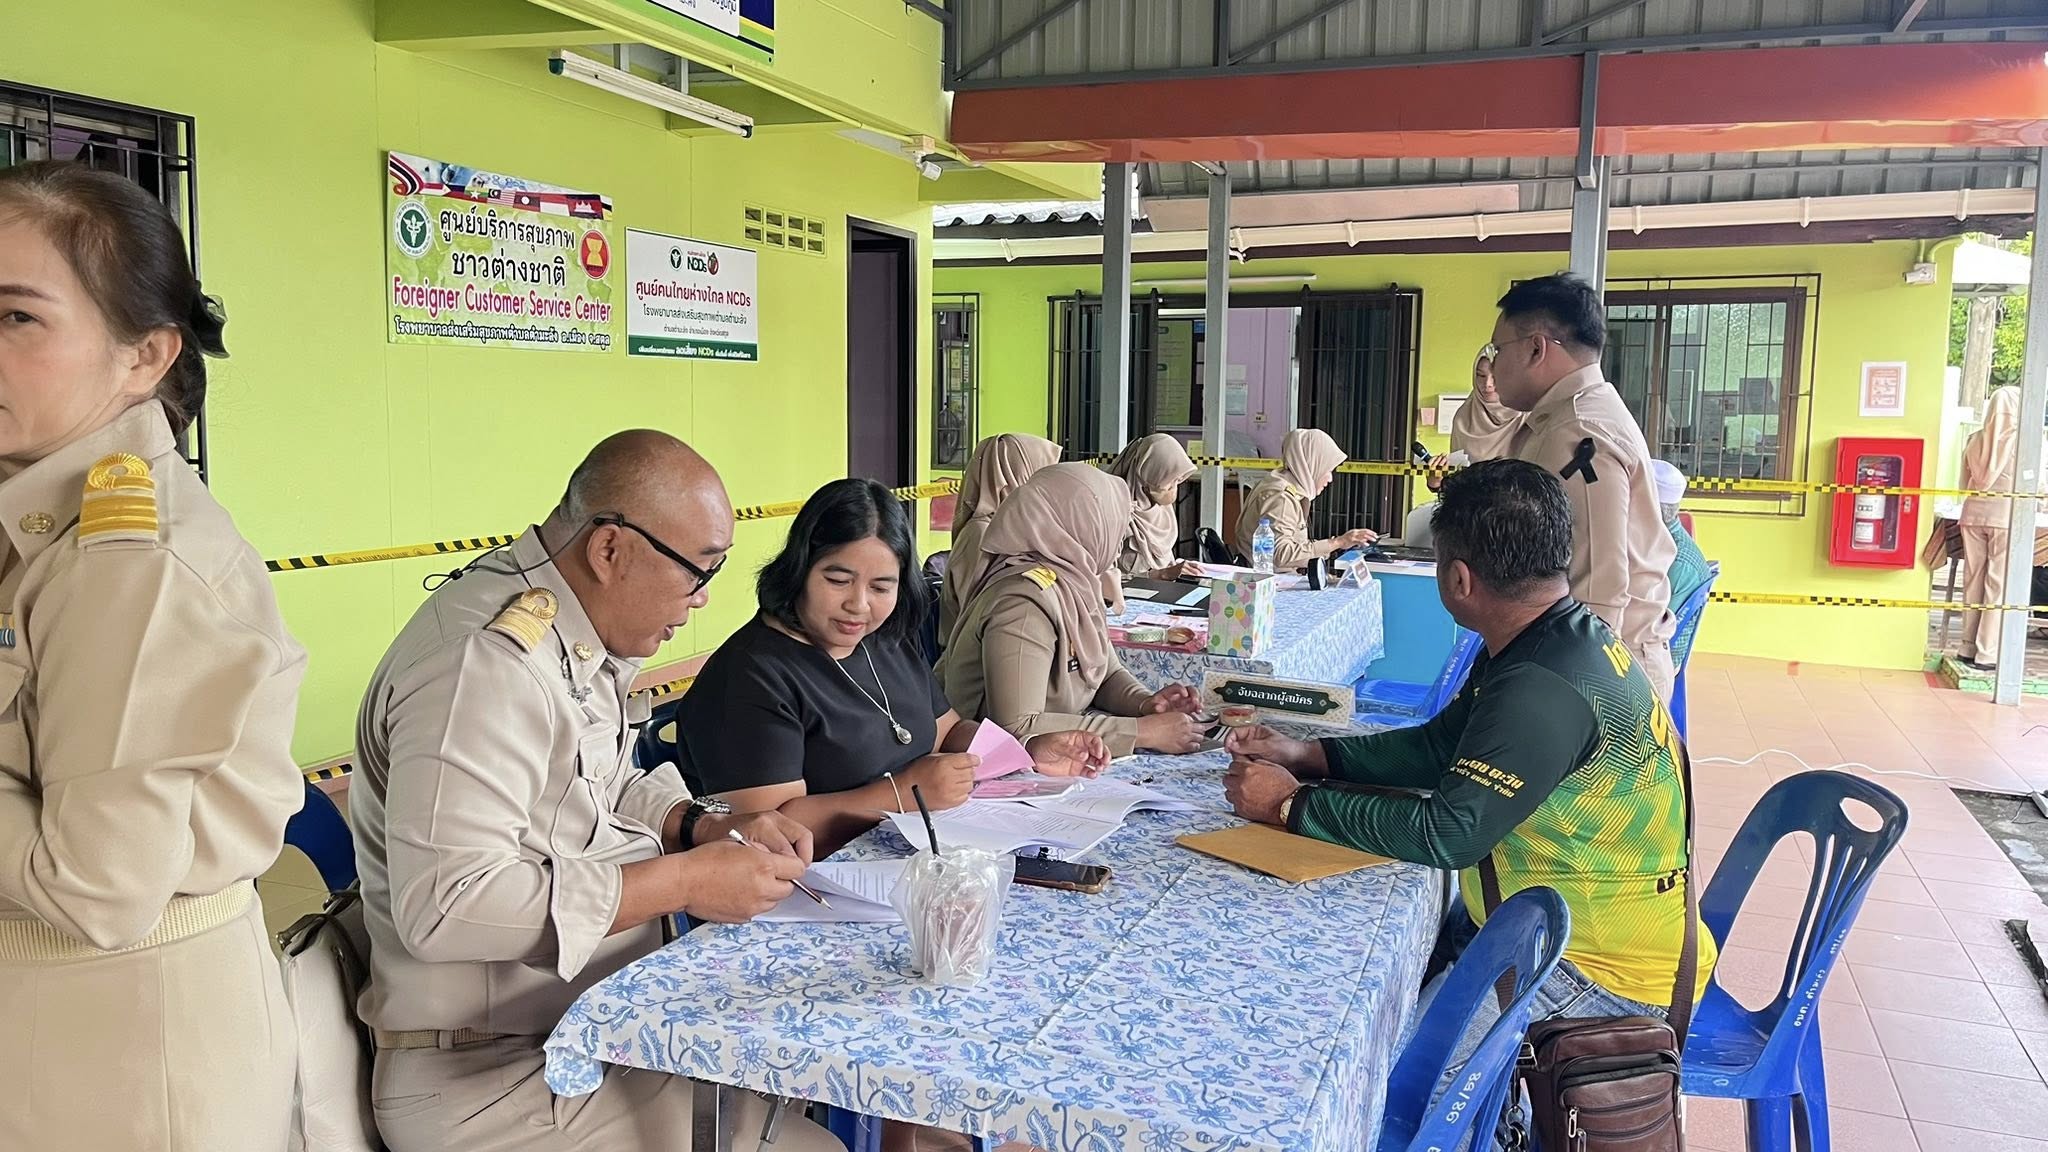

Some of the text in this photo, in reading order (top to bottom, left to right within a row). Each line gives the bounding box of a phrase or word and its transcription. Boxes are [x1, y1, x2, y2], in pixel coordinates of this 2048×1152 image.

[440, 206, 575, 252] ศูนย์บริการสุขภาพ
[452, 248, 566, 287] ชาวต่างชาติ
[394, 276, 611, 322] Foreigner Customer Service Center
[636, 279, 751, 307] ศูนย์คนไทยห่างไกล NCDs
[1238, 686, 1313, 706] จับฉลากผู้สมัคร
